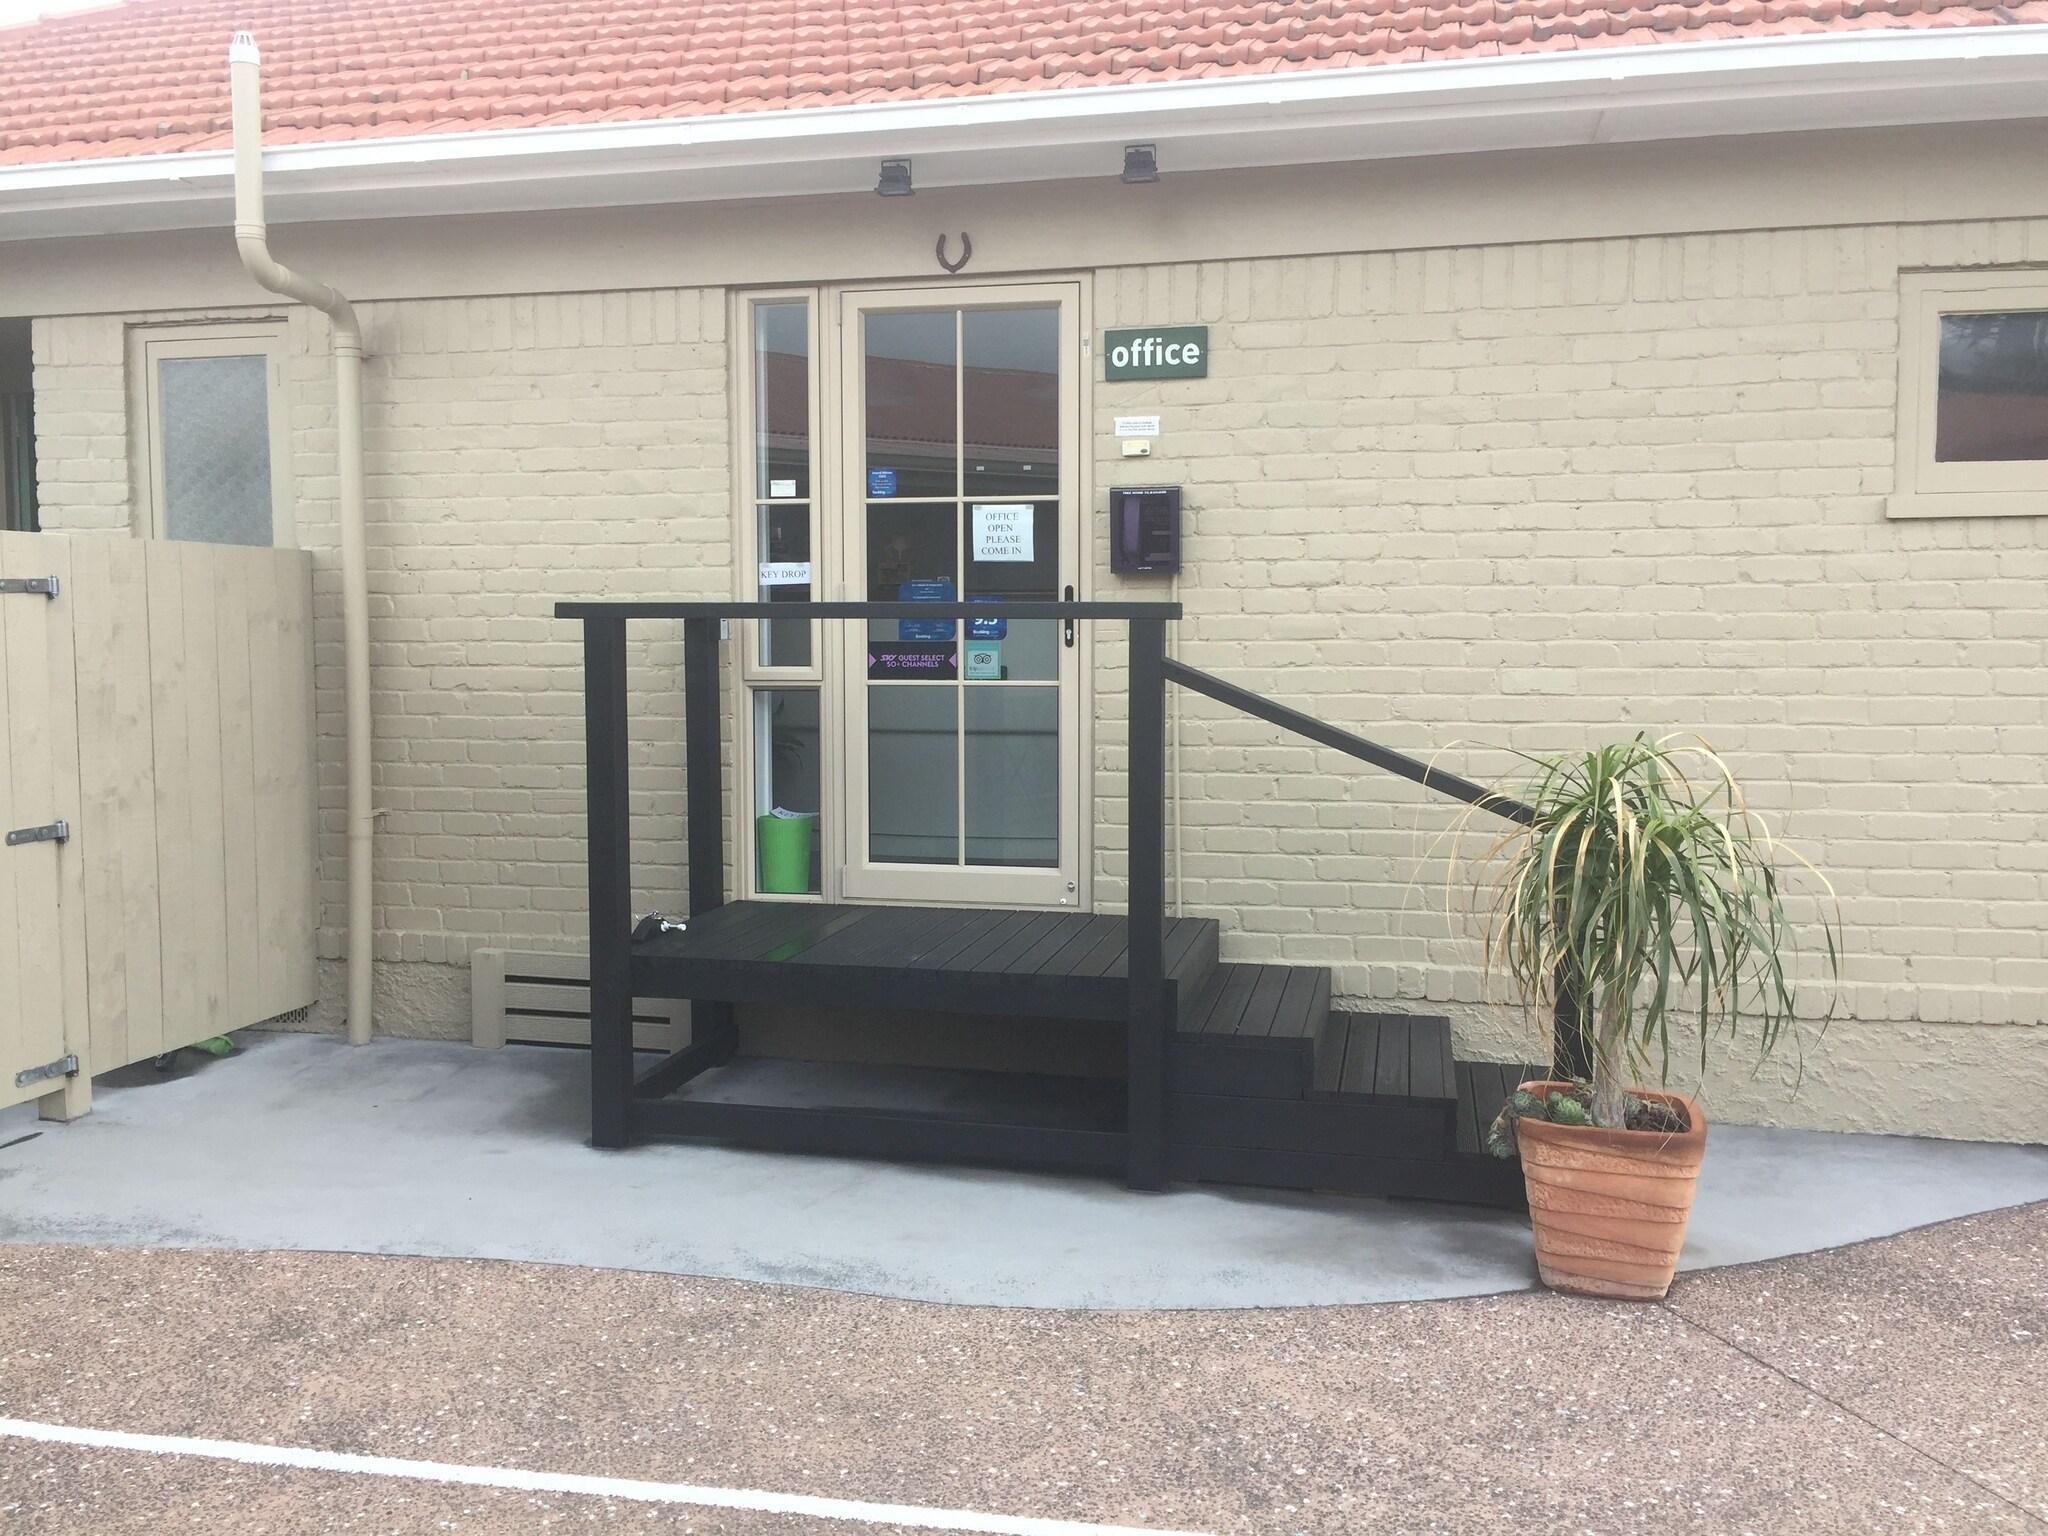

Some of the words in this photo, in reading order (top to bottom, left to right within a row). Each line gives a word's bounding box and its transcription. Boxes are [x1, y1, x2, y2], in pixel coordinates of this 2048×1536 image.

[1112, 337, 1200, 367] office
[985, 512, 1019, 520] OFFICE
[987, 524, 1013, 532] OPEN
[986, 535, 1021, 543] PLEASE
[981, 546, 1009, 555] COME
[1011, 546, 1022, 555] IN
[761, 570, 778, 579] KEY
[781, 570, 807, 578] DROP
